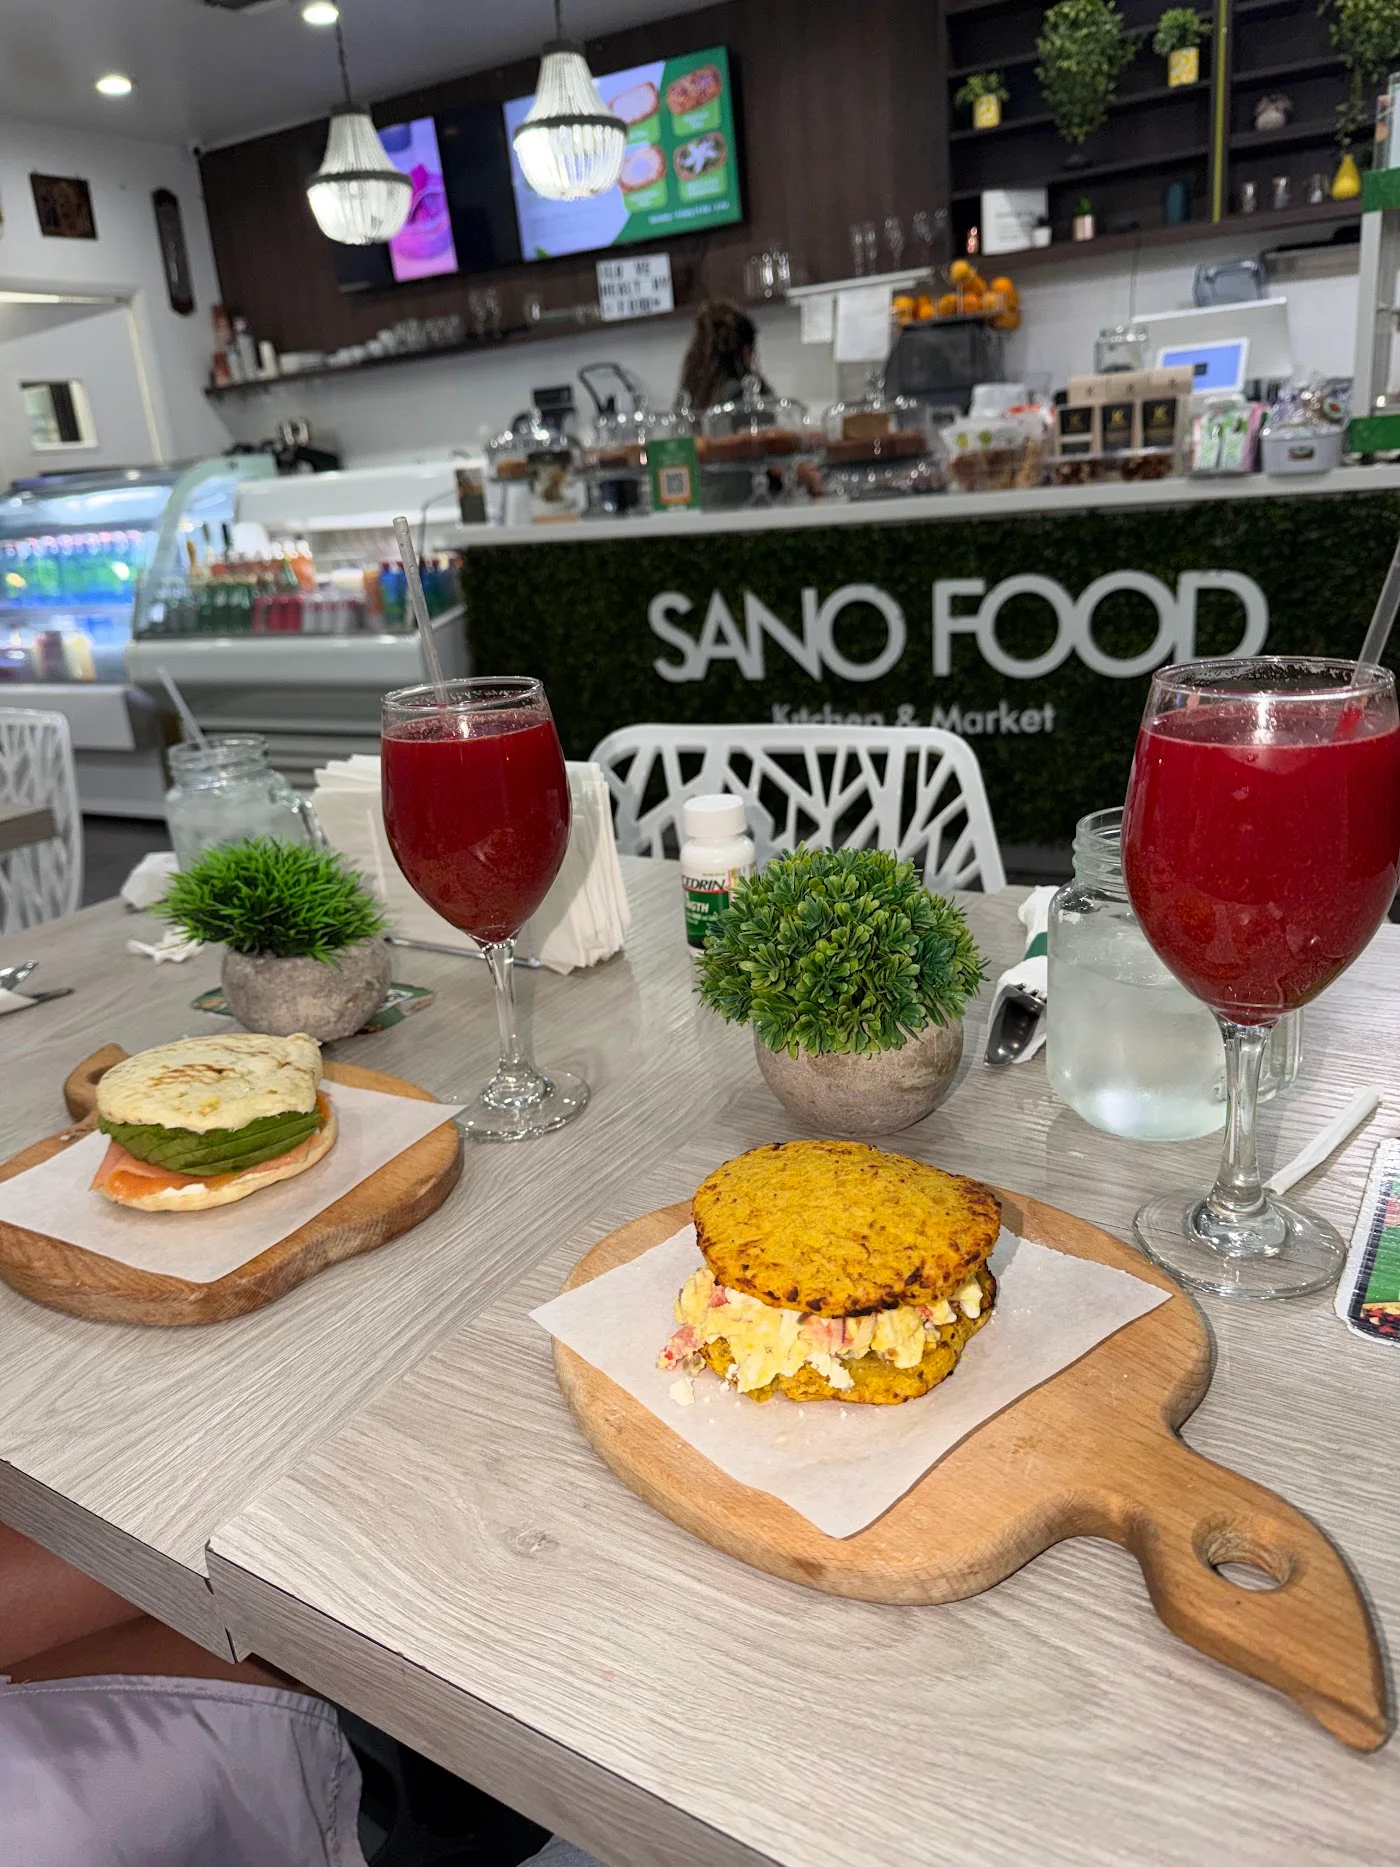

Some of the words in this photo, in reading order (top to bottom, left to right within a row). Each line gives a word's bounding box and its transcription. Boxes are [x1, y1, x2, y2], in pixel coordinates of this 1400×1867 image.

[648, 584, 907, 682] SANO
[932, 571, 1269, 679] FOOD
[895, 702, 921, 728] &
[931, 700, 1056, 734] Market
